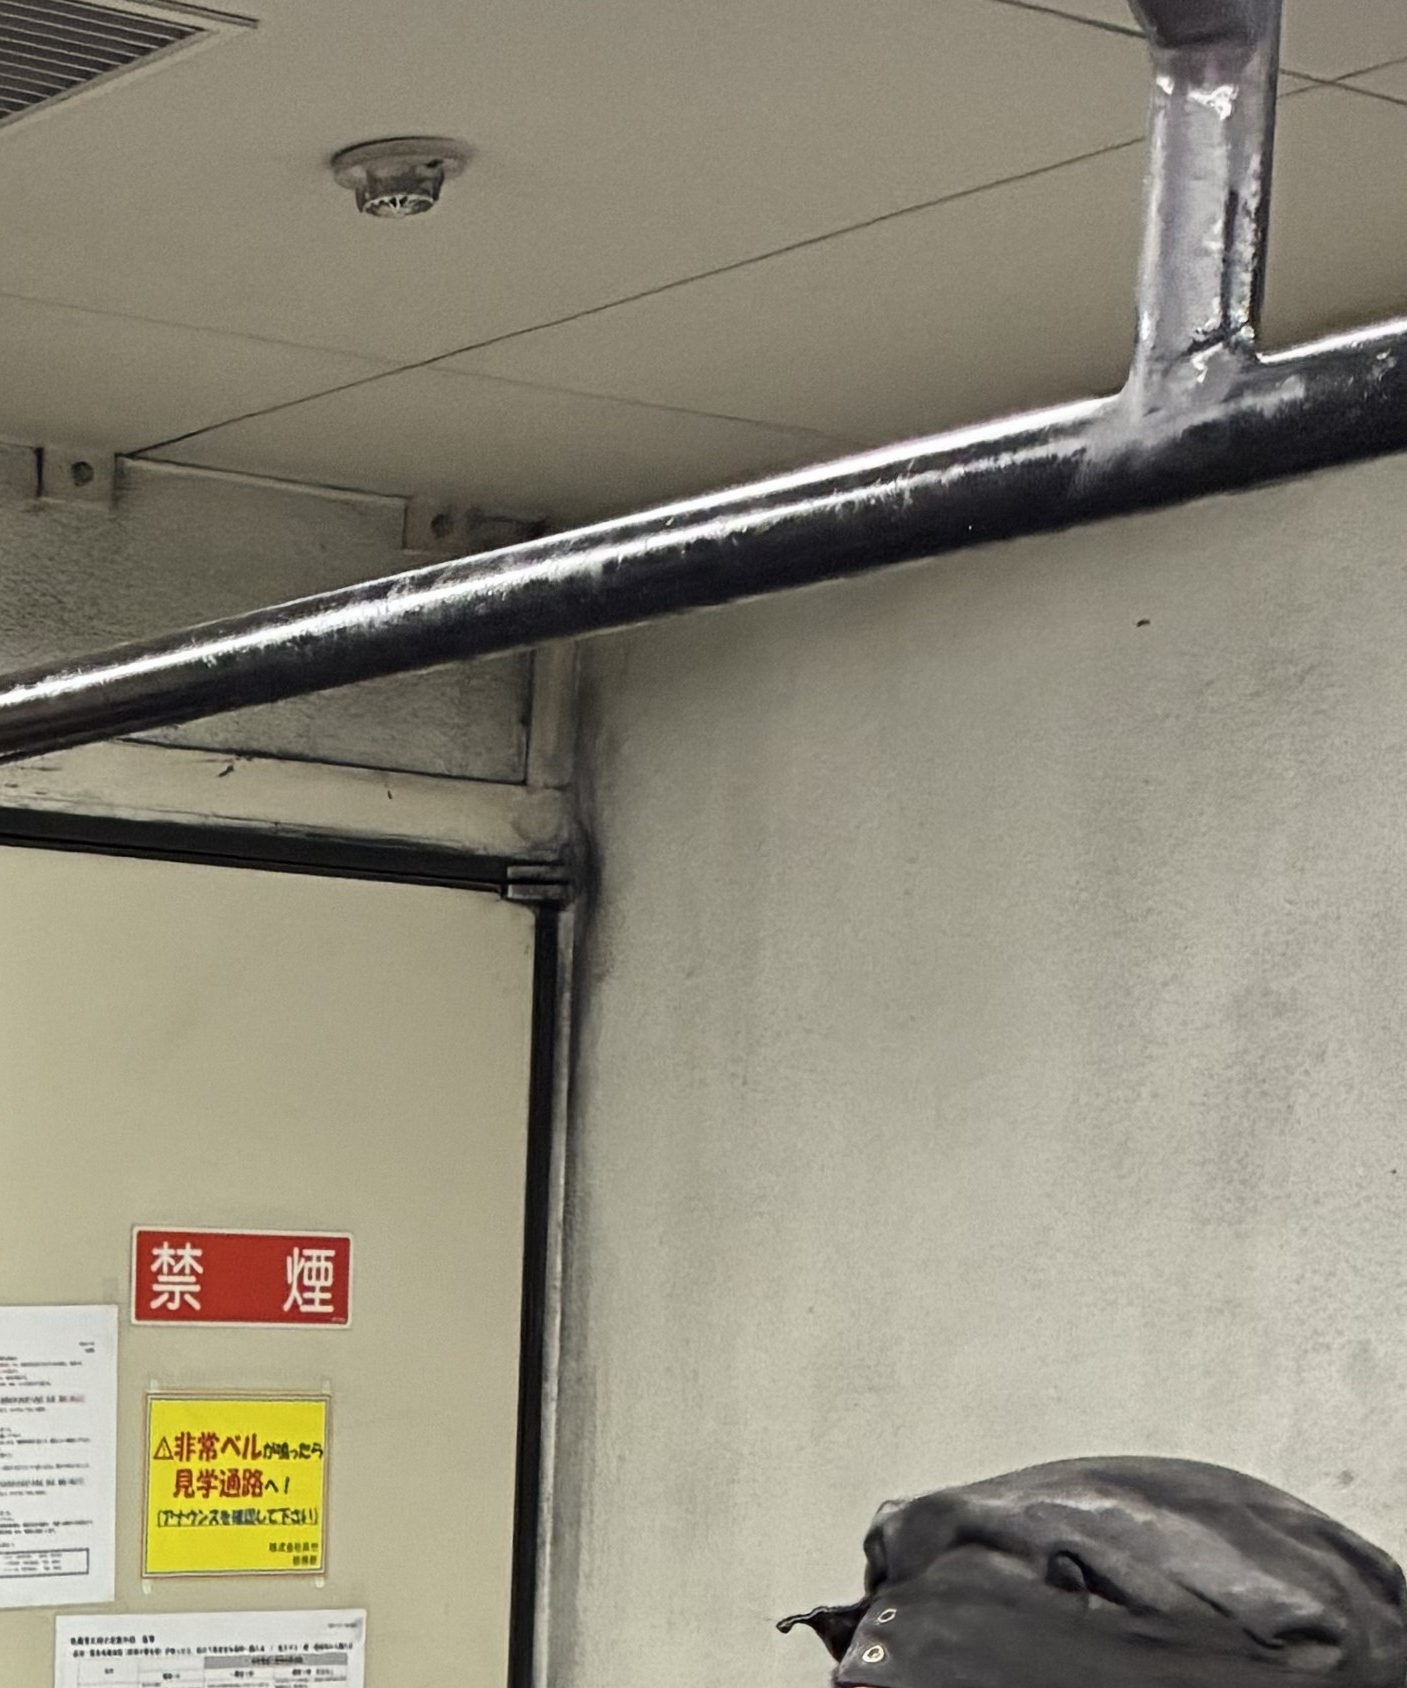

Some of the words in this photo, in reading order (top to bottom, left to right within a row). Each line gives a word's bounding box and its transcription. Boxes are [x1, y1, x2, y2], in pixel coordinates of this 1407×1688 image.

[150, 1241, 336, 1313] 禁煙
[174, 1431, 324, 1462] 非常ベルが鳴ったら
[173, 1467, 291, 1499] 見学通路へ！
